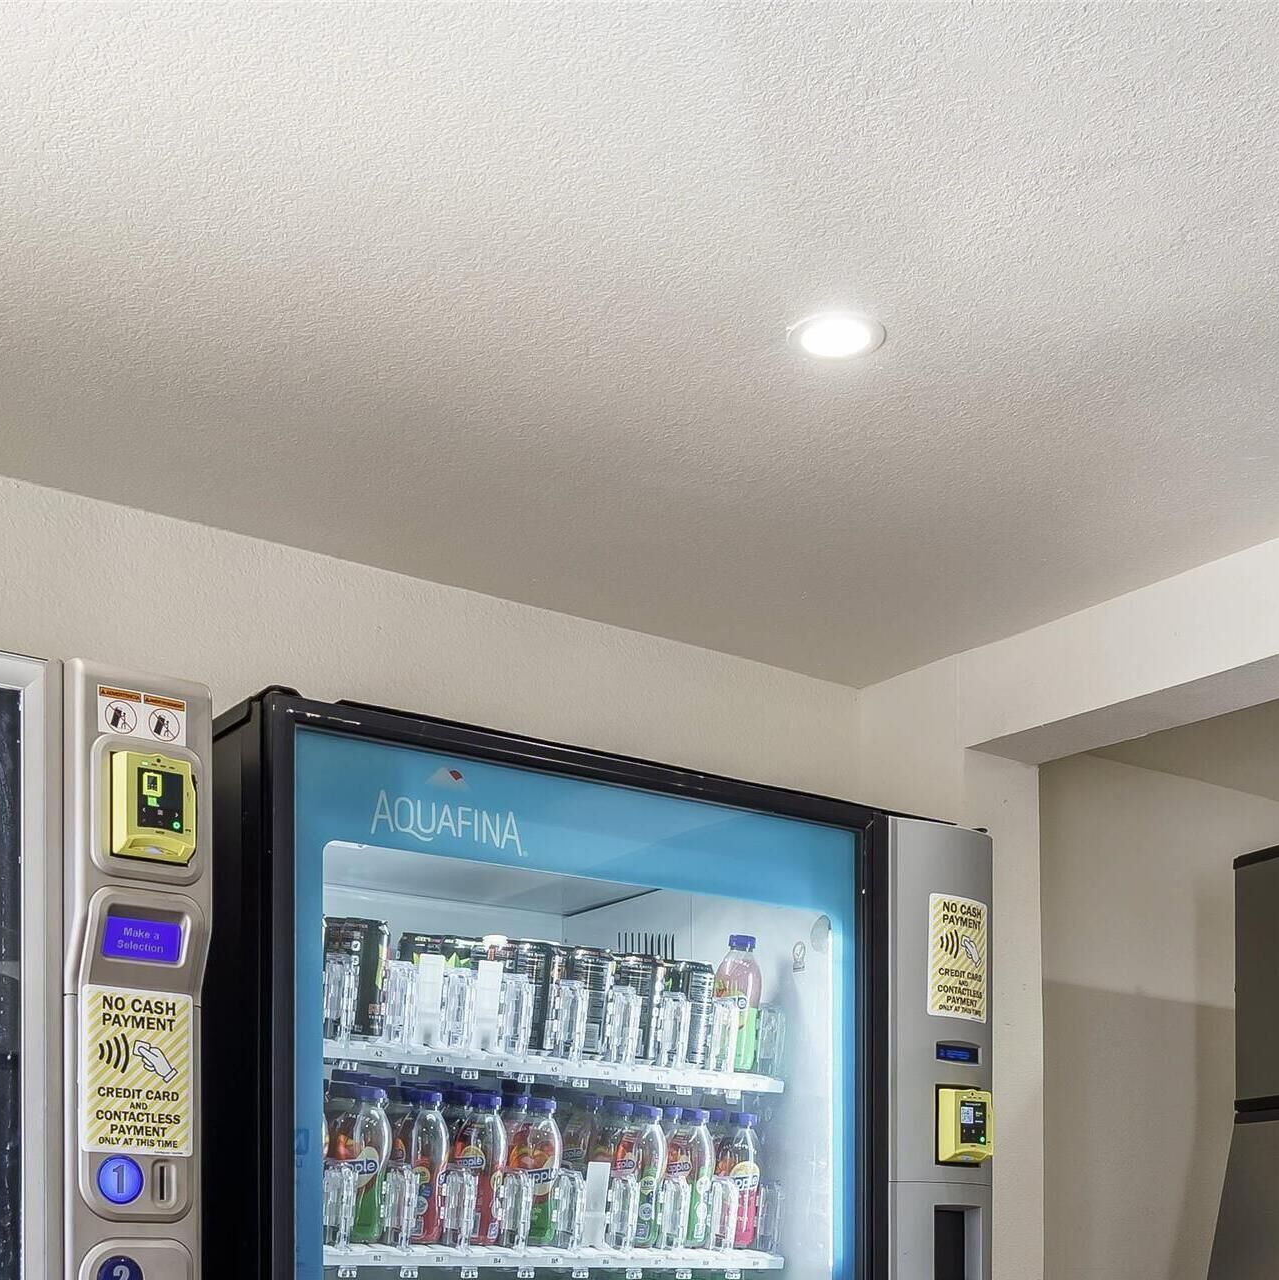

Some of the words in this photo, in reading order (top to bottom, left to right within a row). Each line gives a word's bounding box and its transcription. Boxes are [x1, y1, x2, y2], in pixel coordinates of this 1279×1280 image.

[371, 790, 524, 857] AQUAFINA
[942, 901, 958, 914] NO
[960, 904, 982, 920] CASH
[942, 914, 982, 930] PAYMENT
[123, 926, 151, 940] Make
[116, 938, 164, 954] Selection
[938, 967, 966, 979] CREDIT
[967, 971, 983, 983] CARD
[937, 984, 983, 1000] CONTACTLESS
[102, 995, 126, 1012] NO
[131, 999, 176, 1016] CASH
[946, 995, 977, 1008] PAYMENT
[102, 1012, 176, 1032] PAYMENT
[97, 1086, 143, 1100] CREDIT
[145, 1089, 179, 1102] CARD
[129, 1102, 148, 1111] AND
[96, 1109, 181, 1125] CONTACTLESS
[110, 1124, 167, 1138] PAYMENT
[98, 1135, 120, 1146] ONLY
[122, 1137, 133, 1146] AT
[135, 1138, 155, 1147] THIS
[156, 1139, 178, 1149] TIME
[112, 1164, 126, 1193] 1
